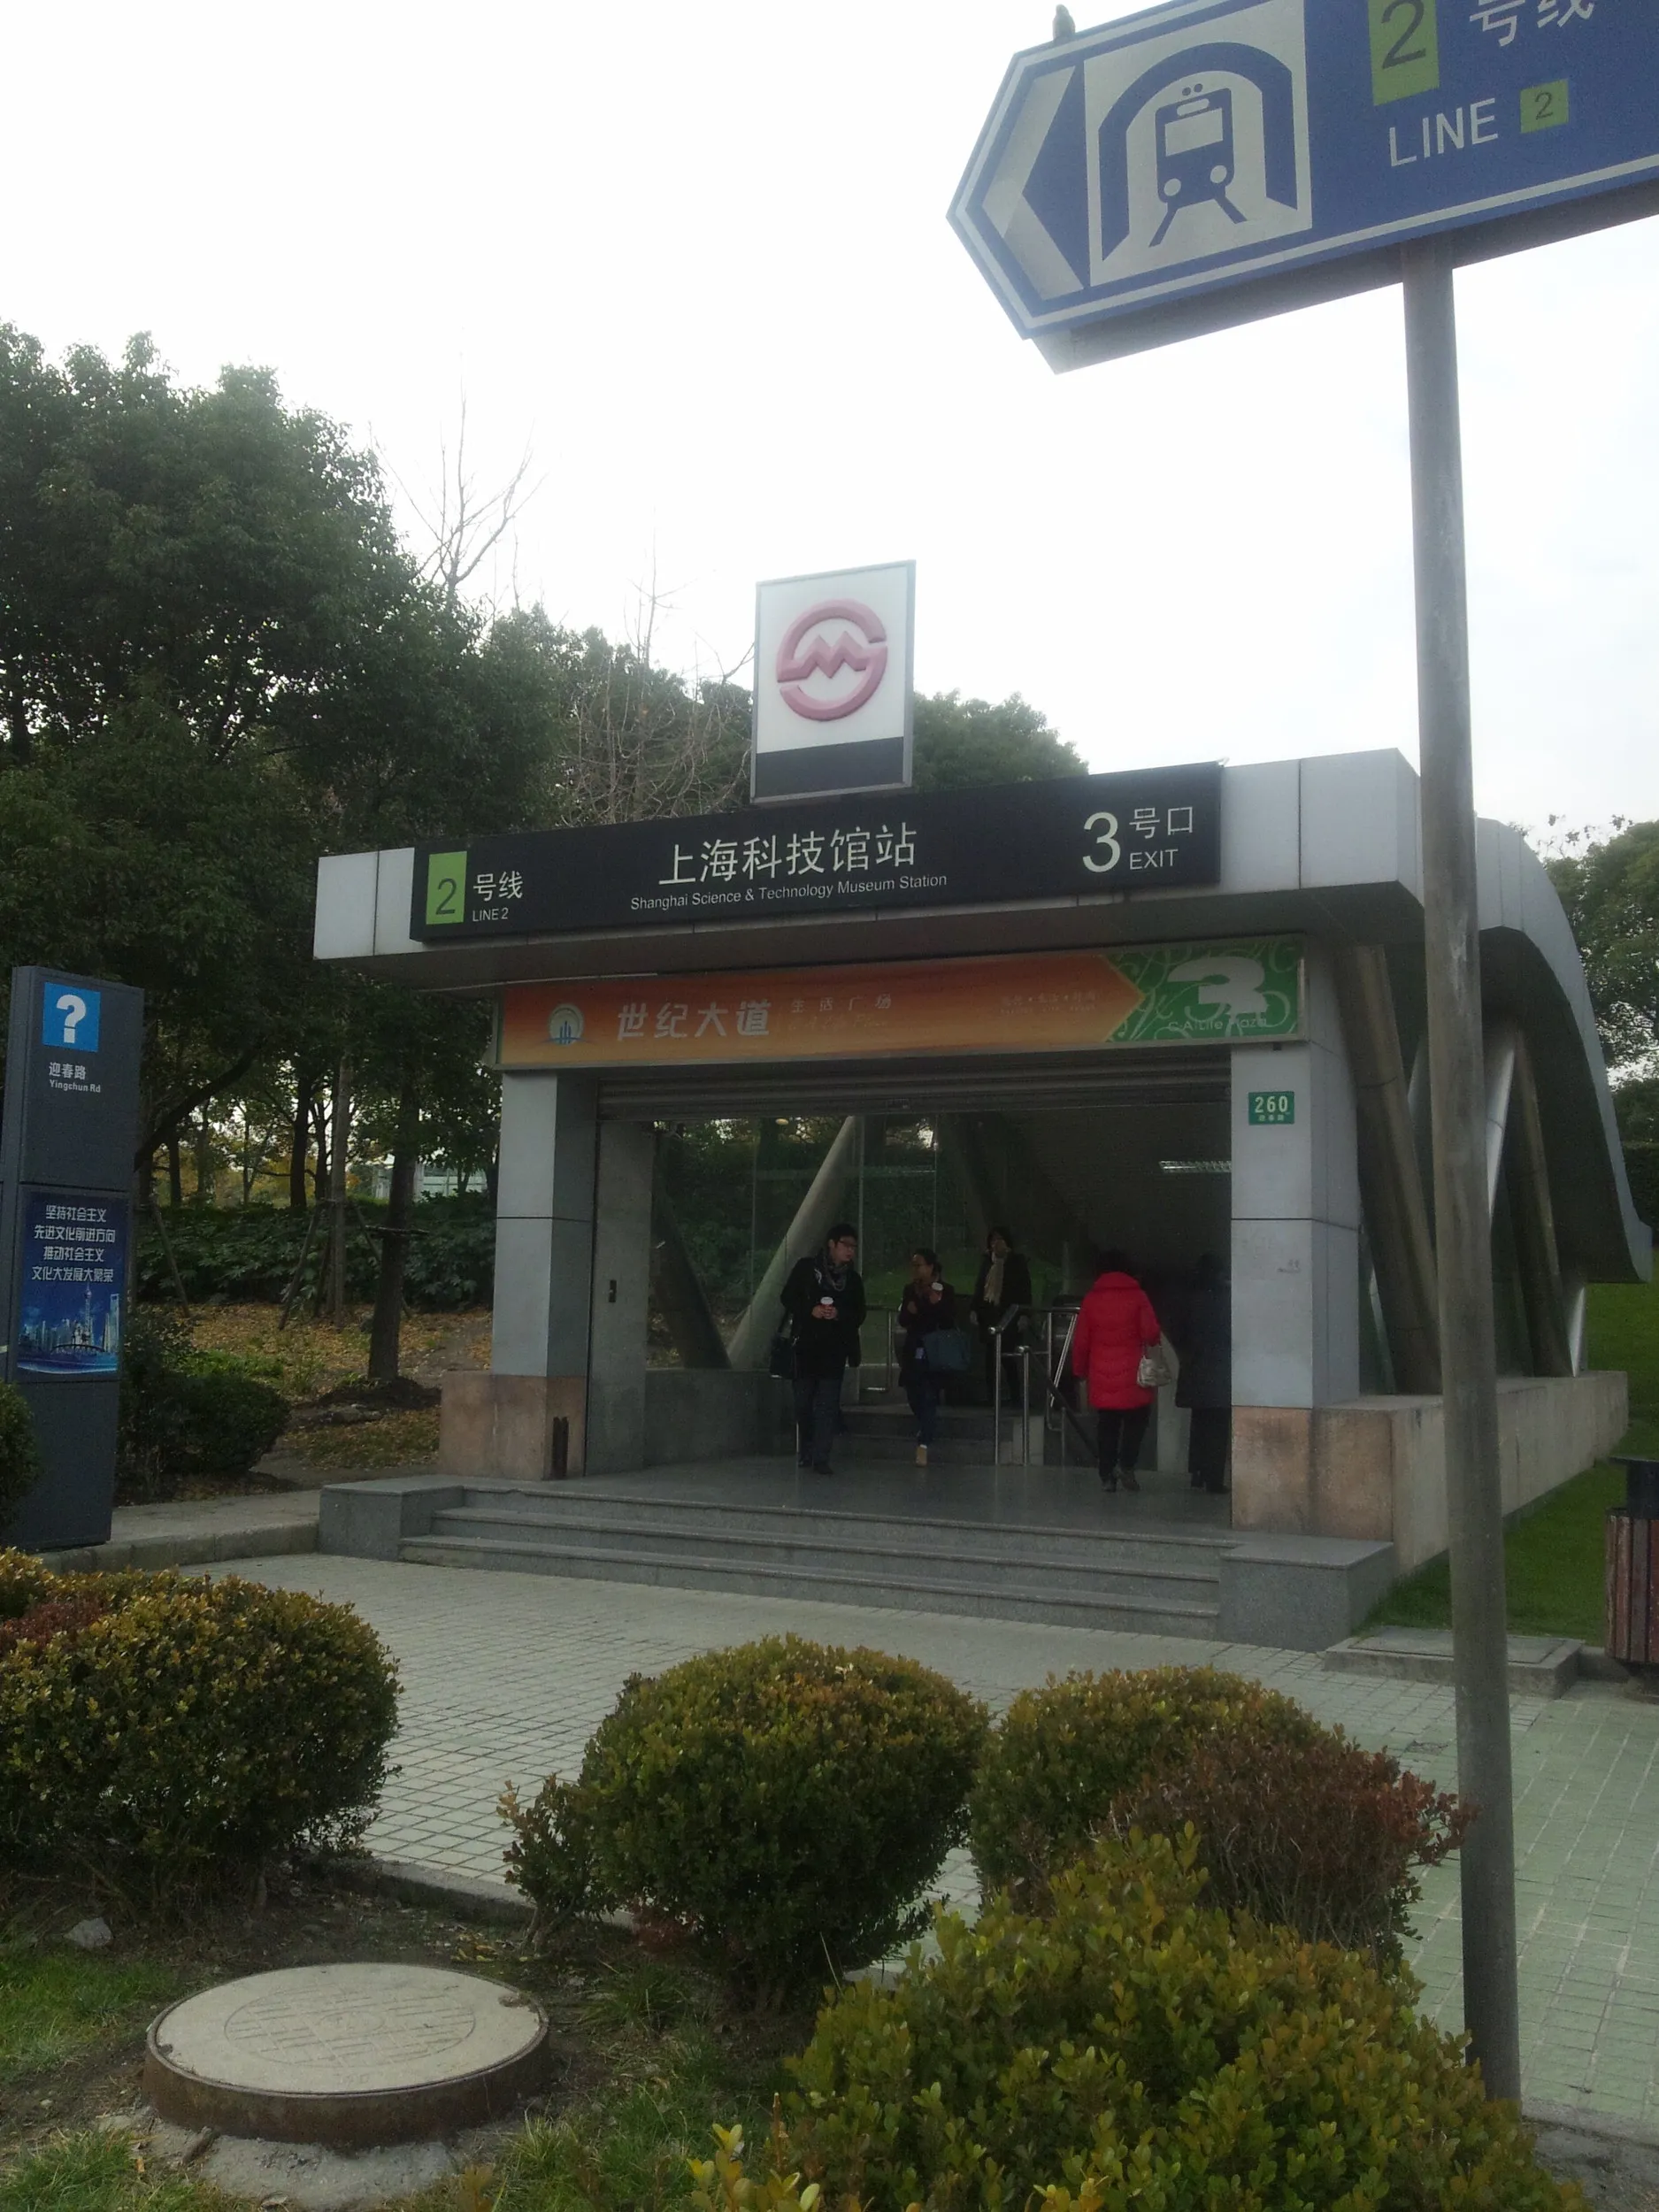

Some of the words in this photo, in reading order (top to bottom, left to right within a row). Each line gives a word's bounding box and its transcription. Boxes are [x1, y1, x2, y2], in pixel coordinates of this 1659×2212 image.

[1380, 0, 1426, 69] 2
[1389, 97, 1498, 166] LINE
[1534, 92, 1554, 120] 2
[1082, 811, 1121, 872] 3
[1129, 807, 1193, 839] 号口
[658, 822, 918, 886] 上海科技馆站
[1129, 849, 1179, 870] EXIT
[435, 878, 457, 915] 2
[473, 871, 523, 901] 号线
[630, 892, 688, 910] Shanghai
[691, 891, 741, 905] Science
[745, 887, 755, 902] &
[758, 883, 833, 900] Technology
[838, 878, 895, 894] Museum
[899, 874, 948, 889] Station
[472, 909, 499, 922] LINE
[501, 907, 509, 919] 2
[617, 998, 772, 1041] 世纪大道
[49, 1062, 87, 1079] 迎春路
[49, 1079, 88, 1092] Yingchun
[89, 1083, 101, 1093] Rd
[1255, 1095, 1287, 1113] 260
[45, 1204, 107, 1223] 坚持社会主义
[34, 1225, 116, 1243] 先进文化前进方向
[43, 1246, 104, 1262] 推动社会主义
[31, 1265, 114, 1283] 文化大发展大繁荣
